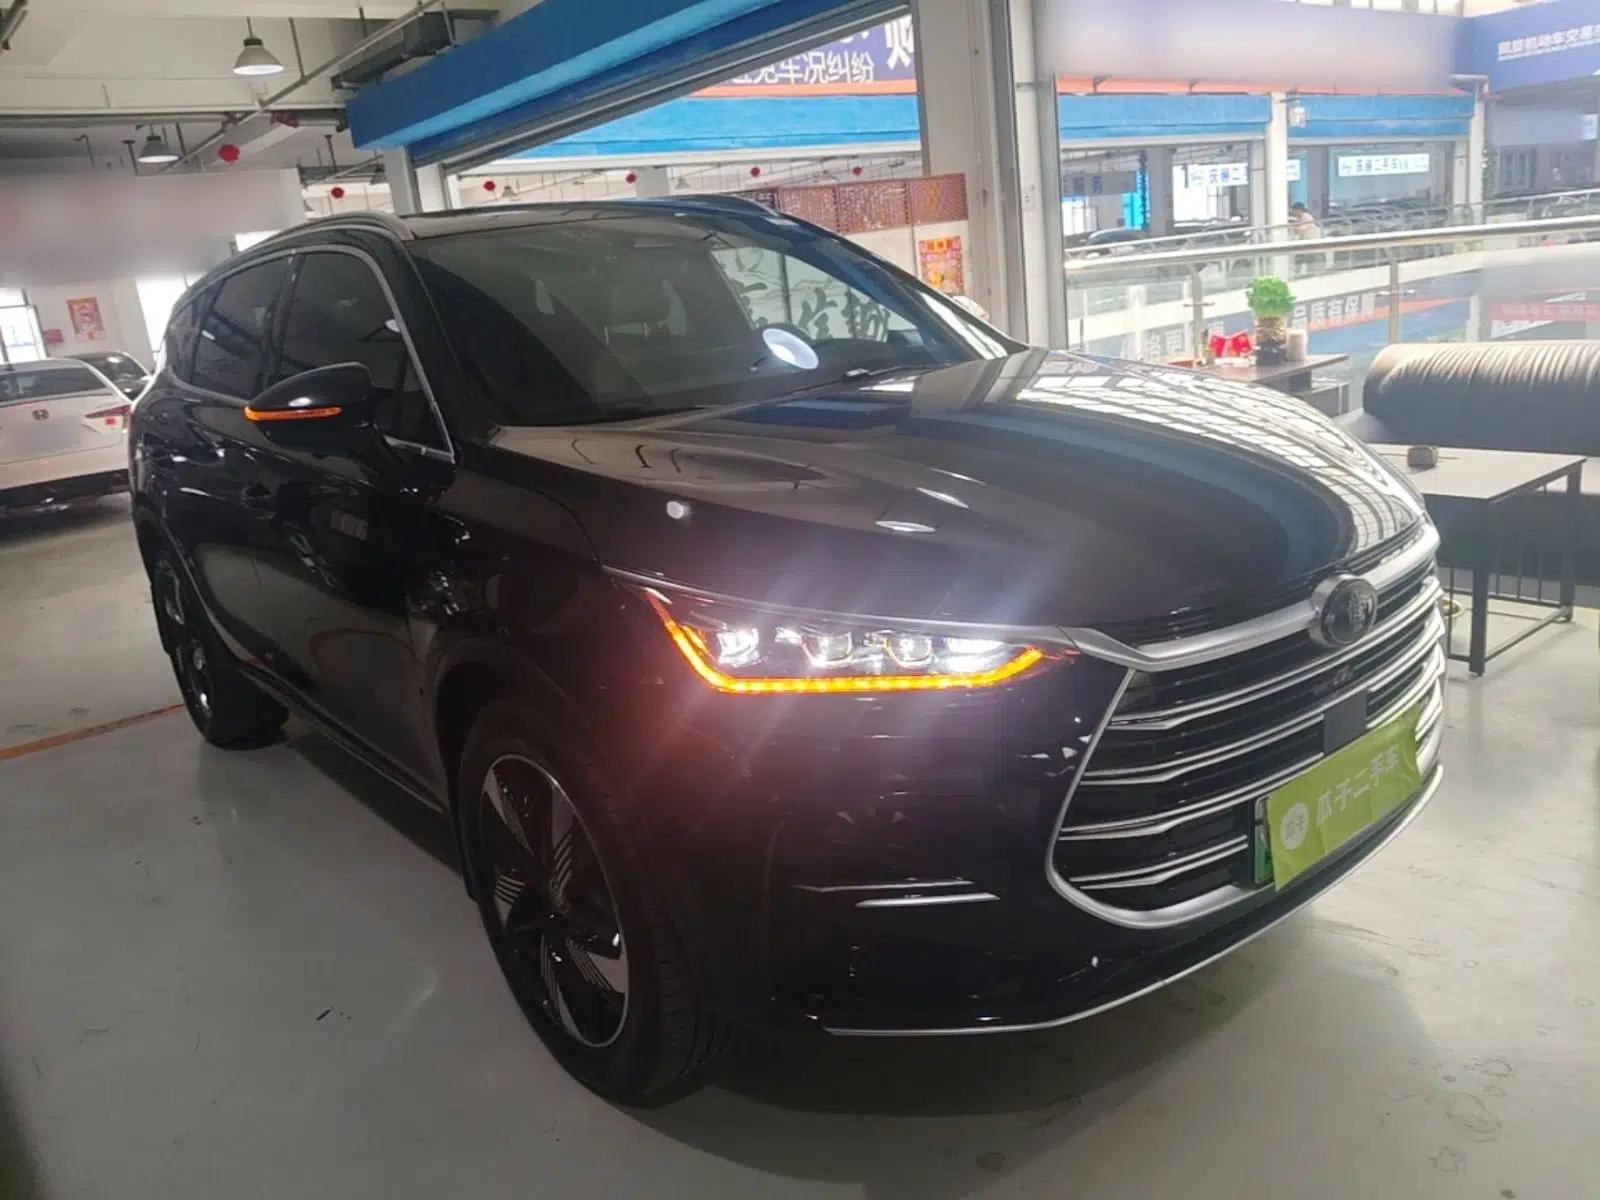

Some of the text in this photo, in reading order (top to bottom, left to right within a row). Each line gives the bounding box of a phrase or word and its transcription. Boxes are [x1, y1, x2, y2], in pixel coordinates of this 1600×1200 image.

[1319, 745, 1398, 824] 瓜子二手车
